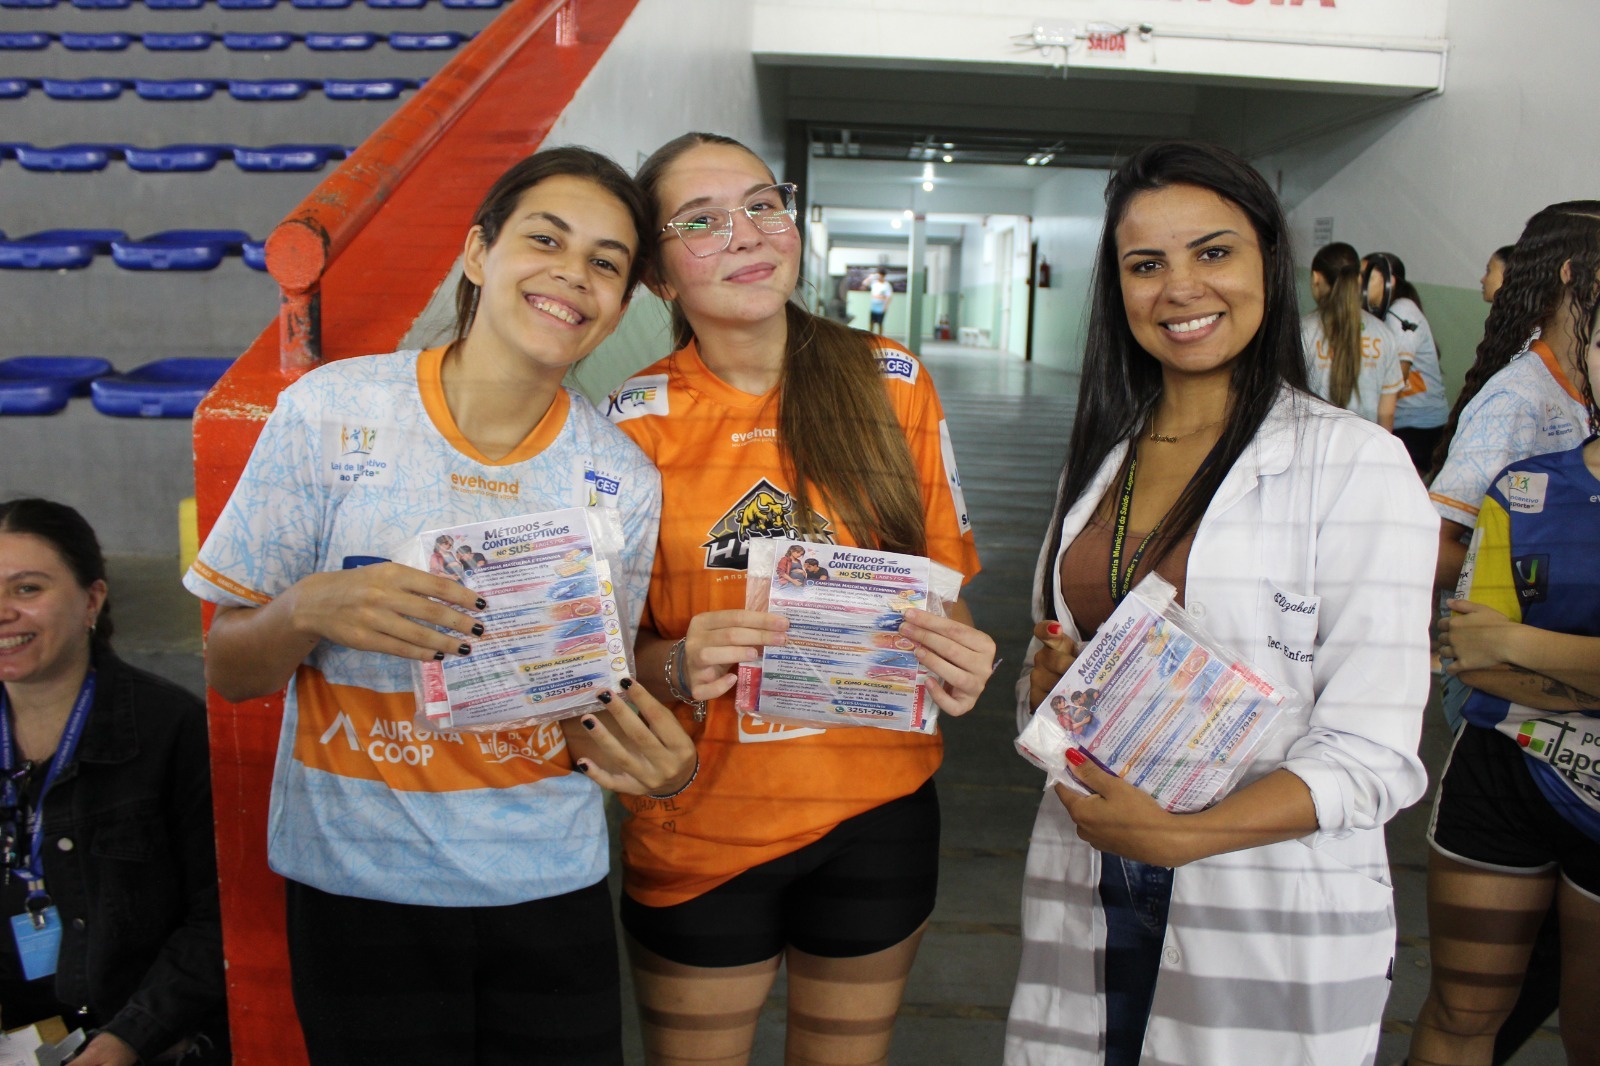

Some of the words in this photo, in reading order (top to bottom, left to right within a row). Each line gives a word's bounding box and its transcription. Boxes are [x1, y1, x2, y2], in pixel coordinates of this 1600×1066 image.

[344, 463, 354, 471] de
[452, 473, 519, 494] evehand
[1120, 496, 1130, 516] Saúde
[1510, 495, 1538, 503] ncentivo
[1119, 514, 1126, 524] da
[482, 525, 569, 550] CONTRACEPTIVOS
[483, 521, 540, 539] MÉTODOS
[508, 543, 531, 555] SUS
[1113, 523, 1125, 558] Municipal
[502, 559, 530, 568] MASCULINA
[832, 551, 884, 563] MÉTODOS
[828, 560, 910, 574] CONTRACEPTIVOS
[1274, 592, 1316, 614] Elizabeth
[1082, 616, 1135, 685] CONTRACEPTIVOS
[1268, 636, 1282, 650] Tec.
[553, 655, 584, 665] ACESSAR?
[1077, 631, 1113, 676] MÉTODOS
[1098, 670, 1106, 680] NO
[1103, 652, 1120, 672] SUS
[544, 680, 593, 697] 3251-7949
[846, 706, 893, 716] 3251-7949
[1225, 710, 1257, 751] 3251-7949
[368, 740, 434, 766] COOP
